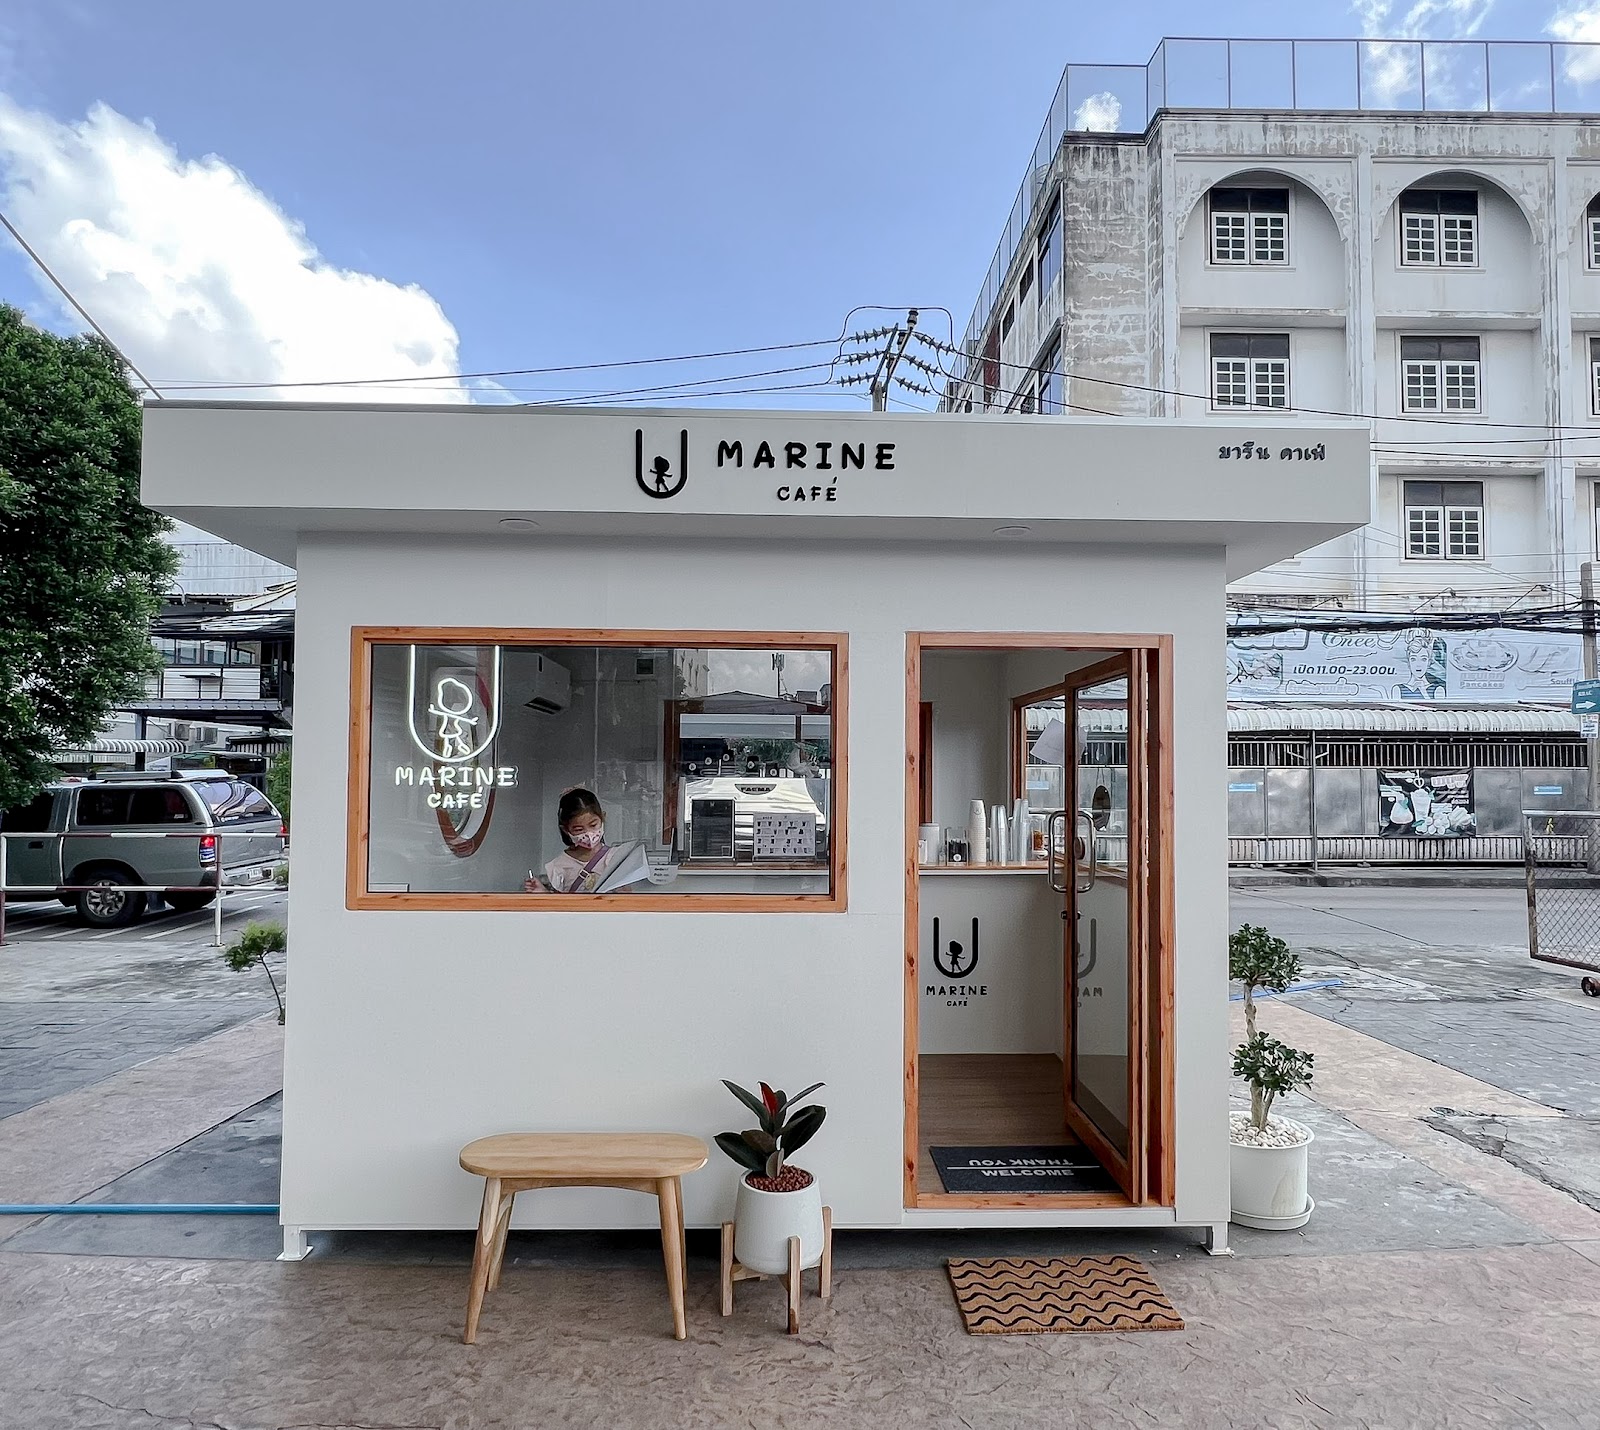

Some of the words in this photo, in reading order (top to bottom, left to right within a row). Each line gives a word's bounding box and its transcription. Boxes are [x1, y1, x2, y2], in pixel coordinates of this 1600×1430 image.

[717, 440, 896, 469] MARINE
[776, 476, 837, 501] CAFÉ
[395, 766, 516, 787] MARINE
[427, 786, 483, 809] CAFÉ
[926, 985, 988, 996] MARINE
[946, 997, 968, 1007] CAFÉ
[981, 1169, 1074, 1177] WELCOME
